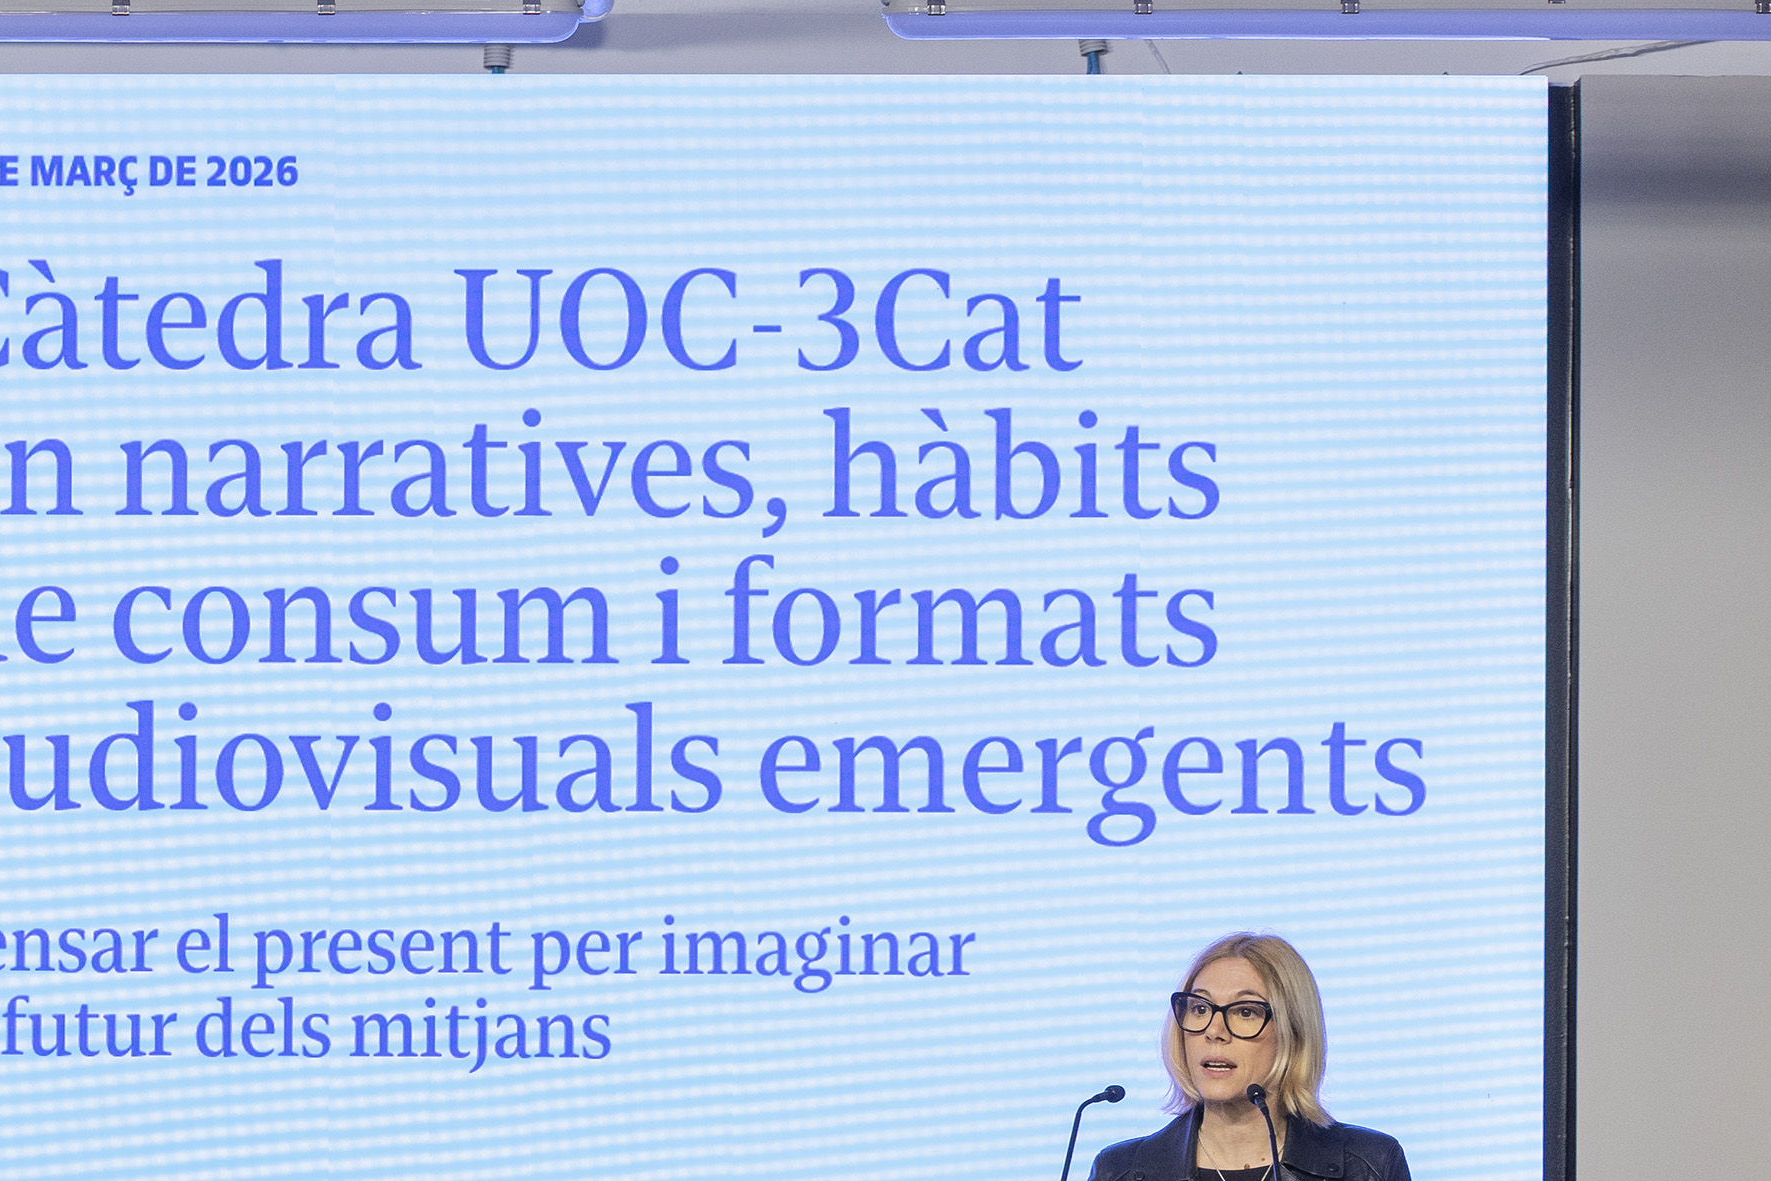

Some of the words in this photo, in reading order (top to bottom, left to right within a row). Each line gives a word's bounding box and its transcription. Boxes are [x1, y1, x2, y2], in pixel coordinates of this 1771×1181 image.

[30, 155, 138, 196] MARÇ
[149, 155, 197, 187] DE
[206, 155, 299, 187] 2026
[453, 267, 1084, 372] UOC-3Cat
[115, 408, 788, 538] narratives,
[822, 407, 1221, 520] hàbits
[113, 585, 620, 665] consum
[651, 555, 690, 665] i
[722, 554, 1218, 668] formats
[759, 721, 1427, 847] emergents
[176, 912, 235, 974] el
[251, 921, 512, 990] present
[529, 930, 644, 991] per
[659, 914, 976, 993] imaginar
[1, 995, 178, 1058] futur
[195, 996, 331, 1059] dels
[349, 996, 612, 1074] mitjans
